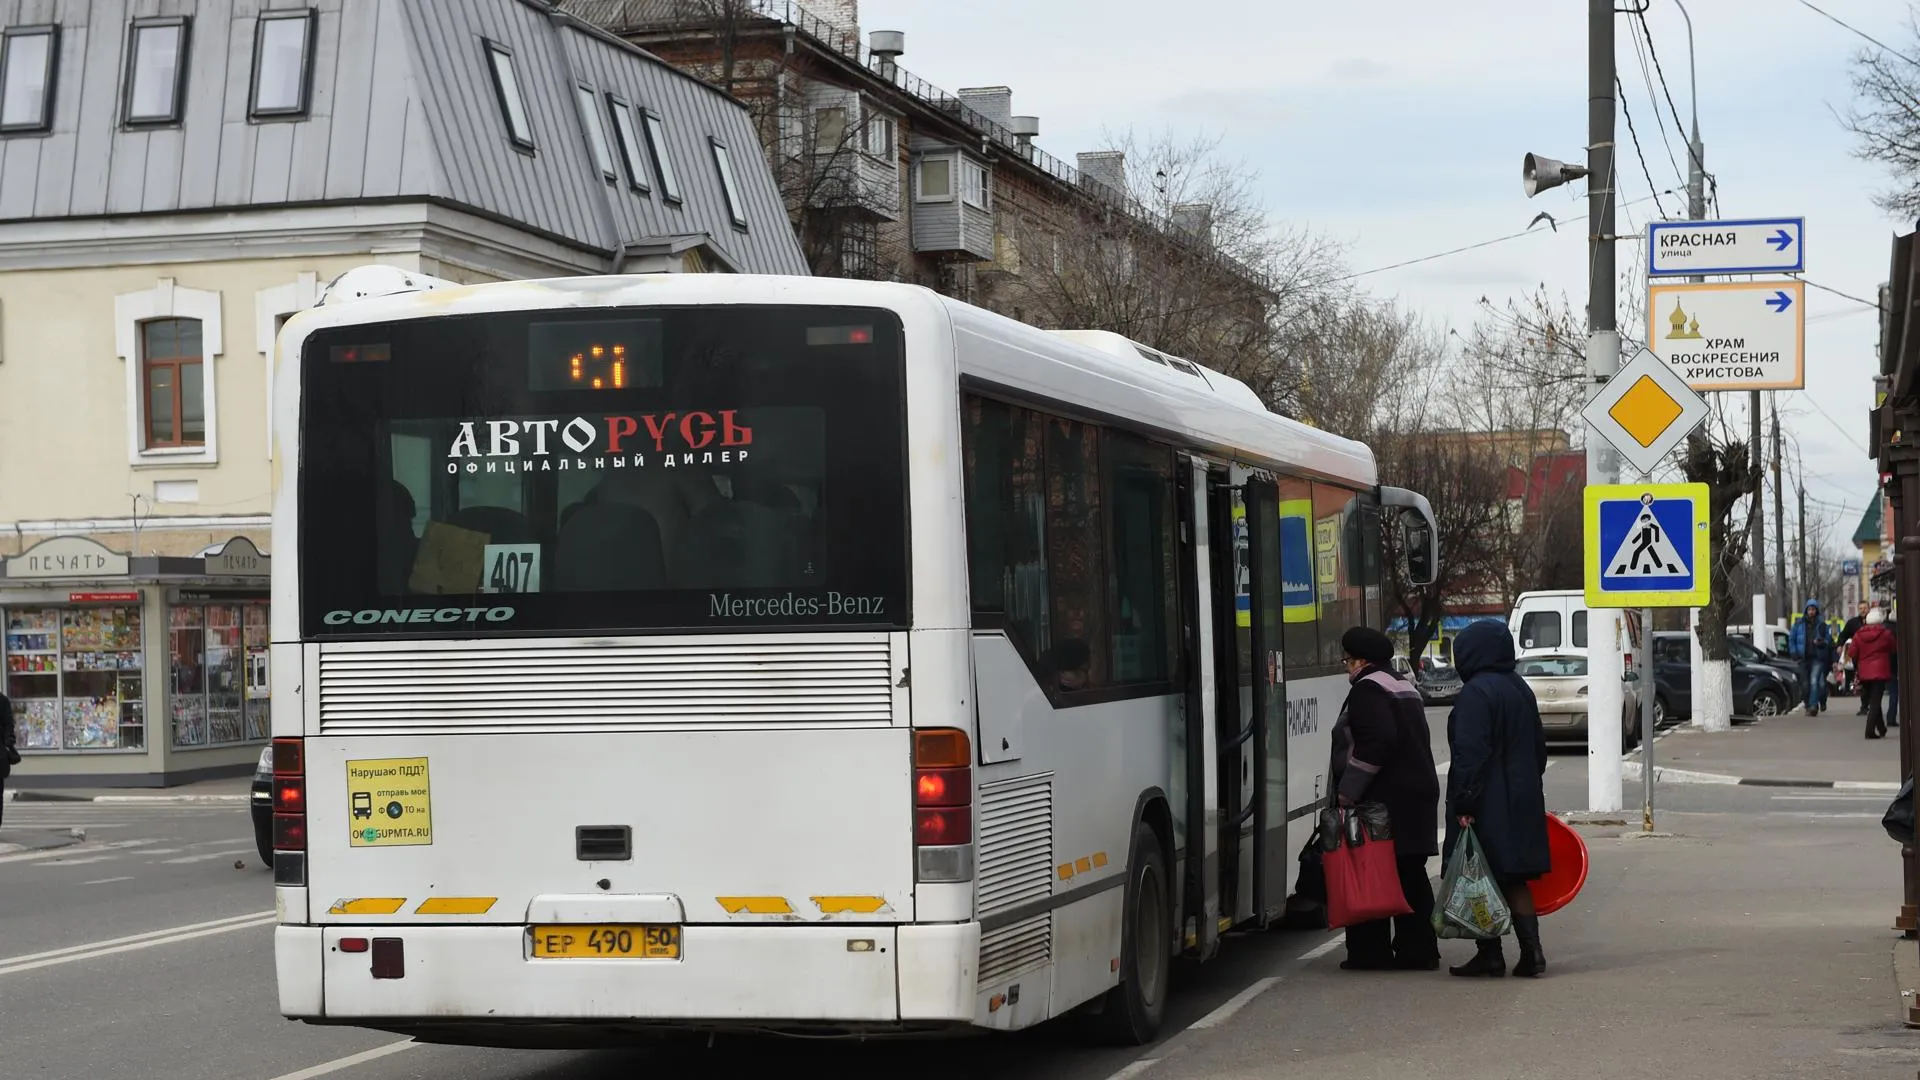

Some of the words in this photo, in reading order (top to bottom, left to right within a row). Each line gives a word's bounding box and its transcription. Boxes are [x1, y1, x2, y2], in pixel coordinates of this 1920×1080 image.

[1660, 232, 1736, 247] КРАСНАЯ
[1661, 250, 1692, 259] улица
[1706, 338, 1745, 350] ХРАМ
[1671, 352, 1779, 365] ВОСКРЕСЕНИЯ
[1686, 367, 1764, 379] ХРИСТОВА
[447, 453, 644, 474] ОФИЦИАЛЬНЫЙ
[665, 450, 748, 467] ДИЛЕР
[29, 554, 106, 571] ПЕЧАТЬ
[223, 555, 257, 569] ПЕЧАТЬ
[490, 552, 534, 593] 407
[709, 591, 885, 617] Mercedes-Benz
[323, 606, 515, 625] CONECTO
[350, 767, 397, 780] Нарушаю
[399, 765, 425, 776] ПДД?
[377, 789, 409, 798] отправь
[411, 788, 426, 796] мое
[588, 928, 632, 953] 490
[647, 927, 671, 946] 50
